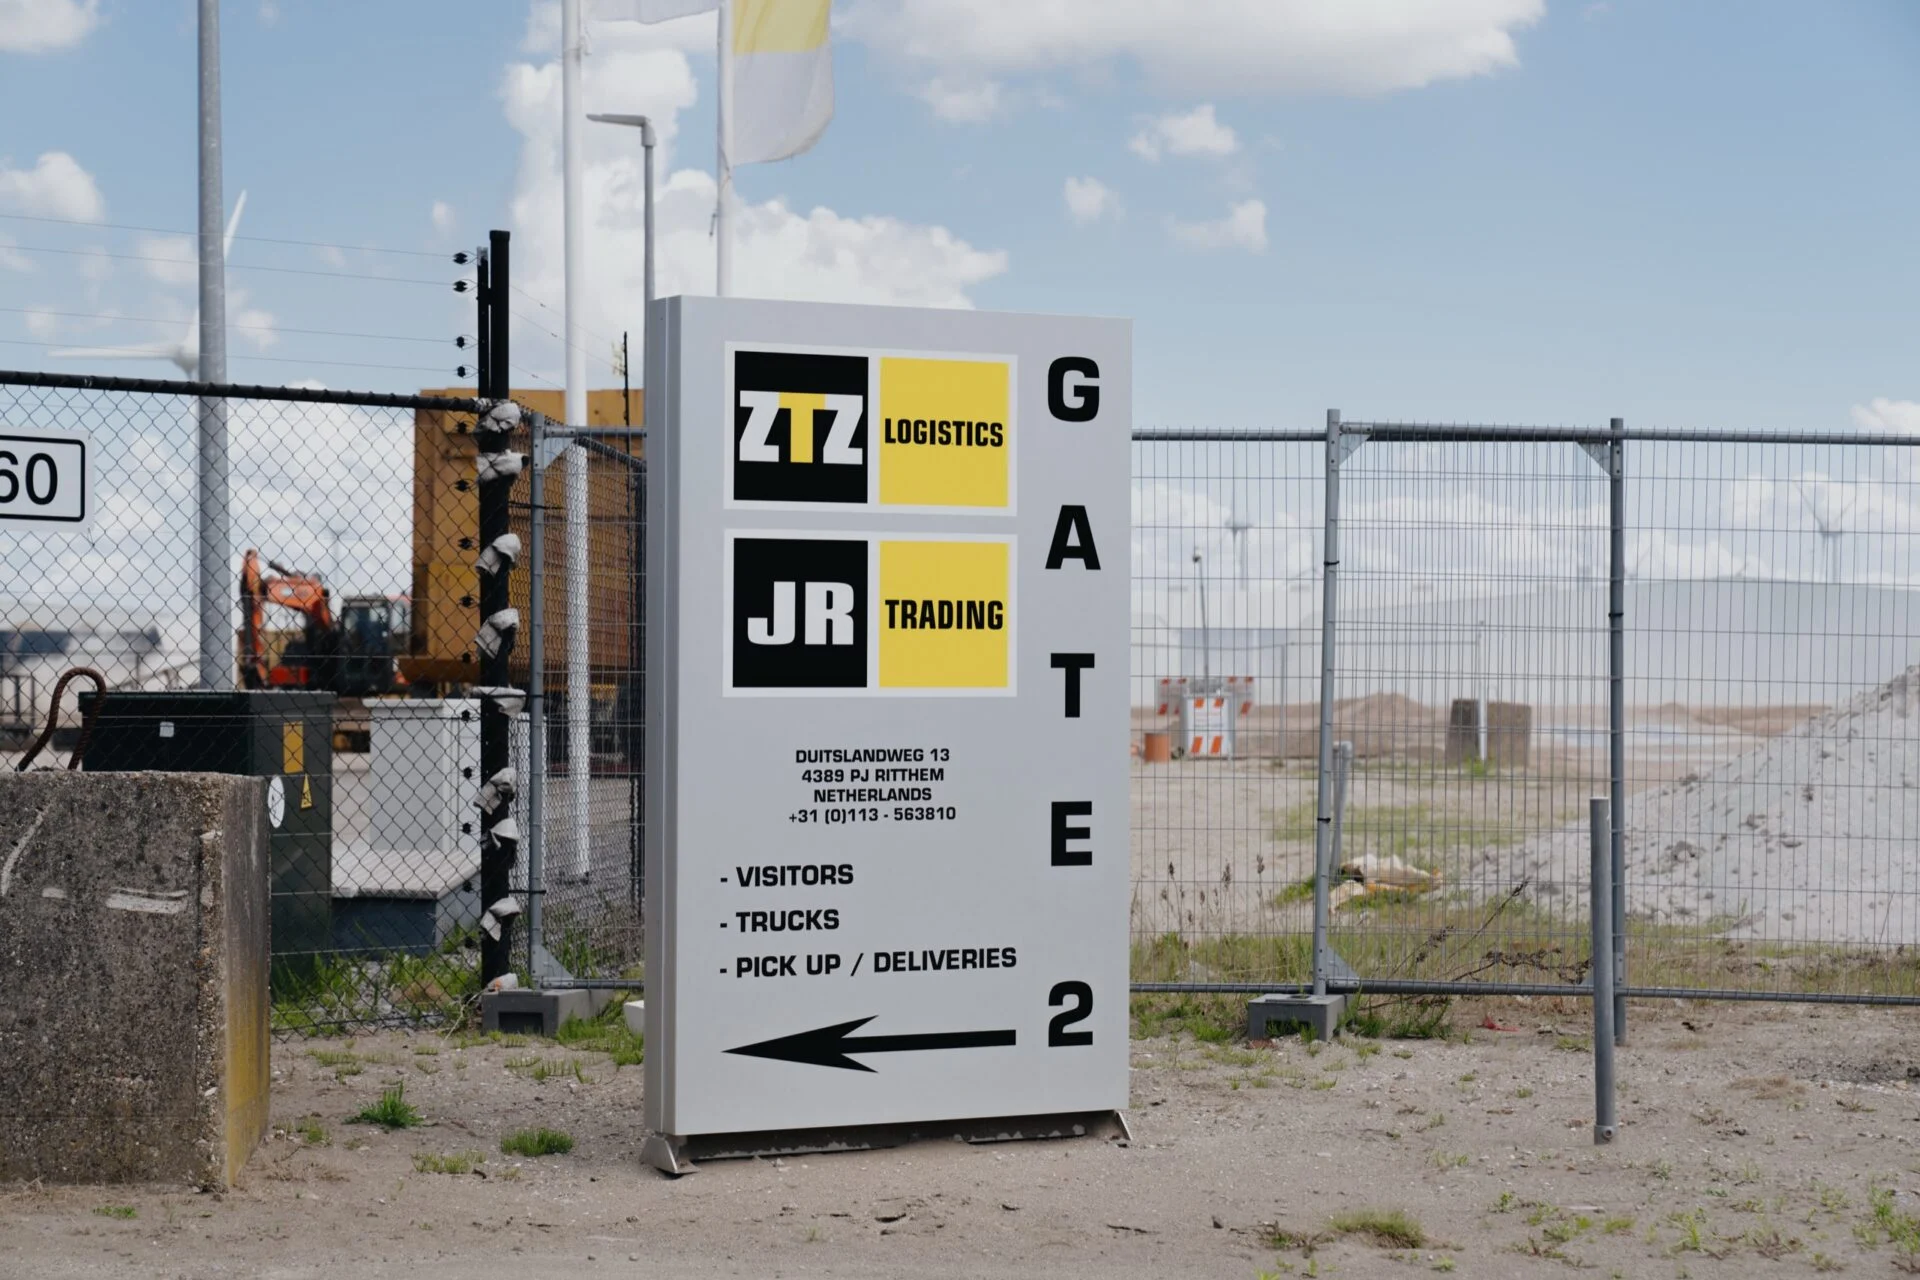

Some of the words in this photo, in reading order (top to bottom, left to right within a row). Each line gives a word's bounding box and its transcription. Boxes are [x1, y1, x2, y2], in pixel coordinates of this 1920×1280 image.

[739, 390, 864, 465] ZTZ
[884, 418, 1004, 448] LOGISTICS
[747, 580, 855, 646] JR
[884, 599, 1004, 631] TRADING
[795, 748, 924, 764] DUITSLANDWEG
[930, 748, 950, 762] 13
[801, 768, 845, 783] 4389
[850, 768, 870, 783] PJ
[875, 767, 945, 782] RITTHEM
[813, 787, 932, 803] NETHERLANDS
[788, 809, 818, 824] +31
[824, 807, 879, 825] (0)113
[893, 806, 956, 821] 563810
[735, 863, 854, 888] VISITORS
[735, 908, 840, 933] TRUCKS
[736, 954, 797, 979] PICK
[806, 953, 841, 976] UP
[850, 952, 864, 977] /
[873, 946, 1017, 973] DELIVERIES
[1047, 980, 1094, 1048] 2
